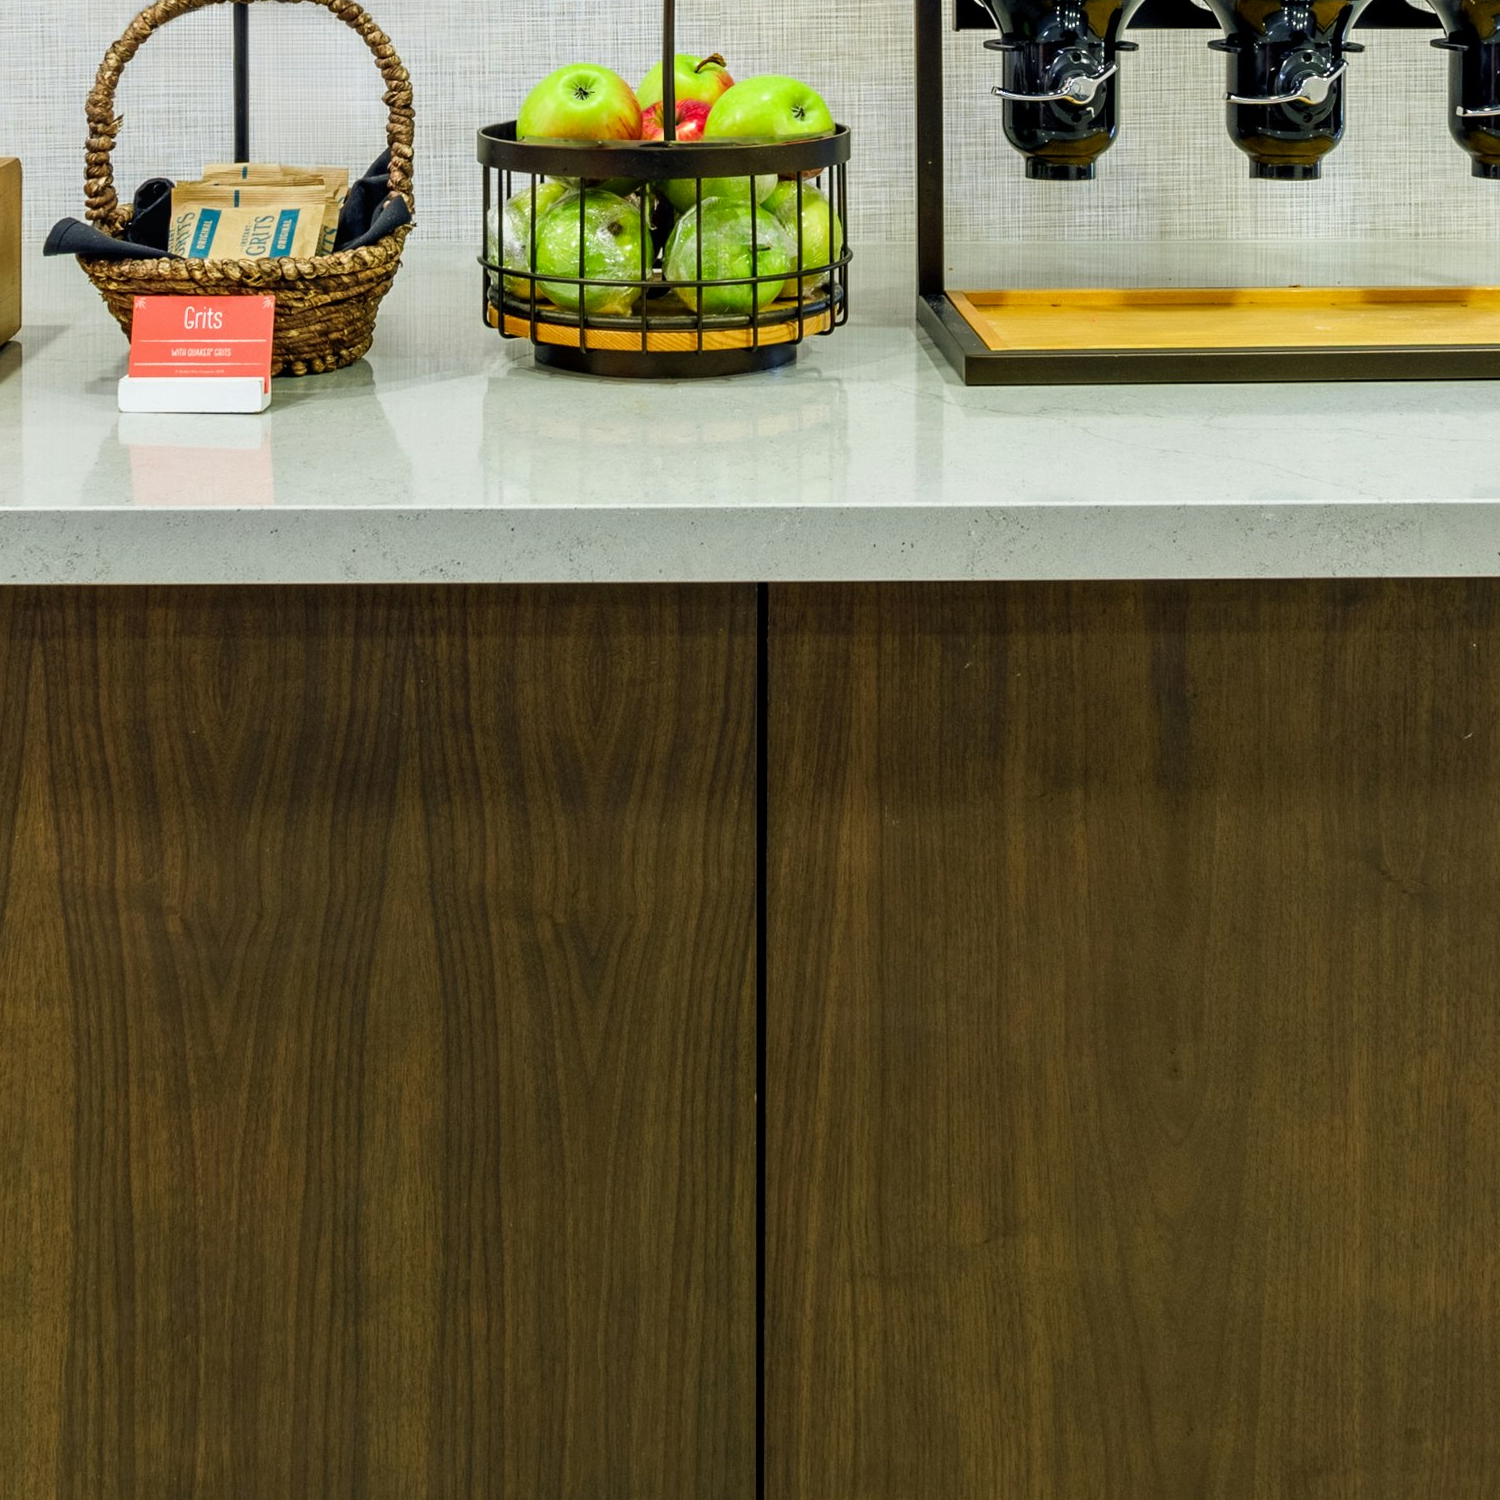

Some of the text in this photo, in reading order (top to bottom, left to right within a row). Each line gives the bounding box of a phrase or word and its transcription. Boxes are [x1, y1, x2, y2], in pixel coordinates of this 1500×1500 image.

[196, 219, 213, 250] ORIGINAL
[245, 214, 275, 256] GRITS
[276, 219, 293, 250] ORIGINAL
[184, 306, 223, 330] Grits
[171, 348, 187, 357] WITH
[214, 348, 232, 357] GRITS
